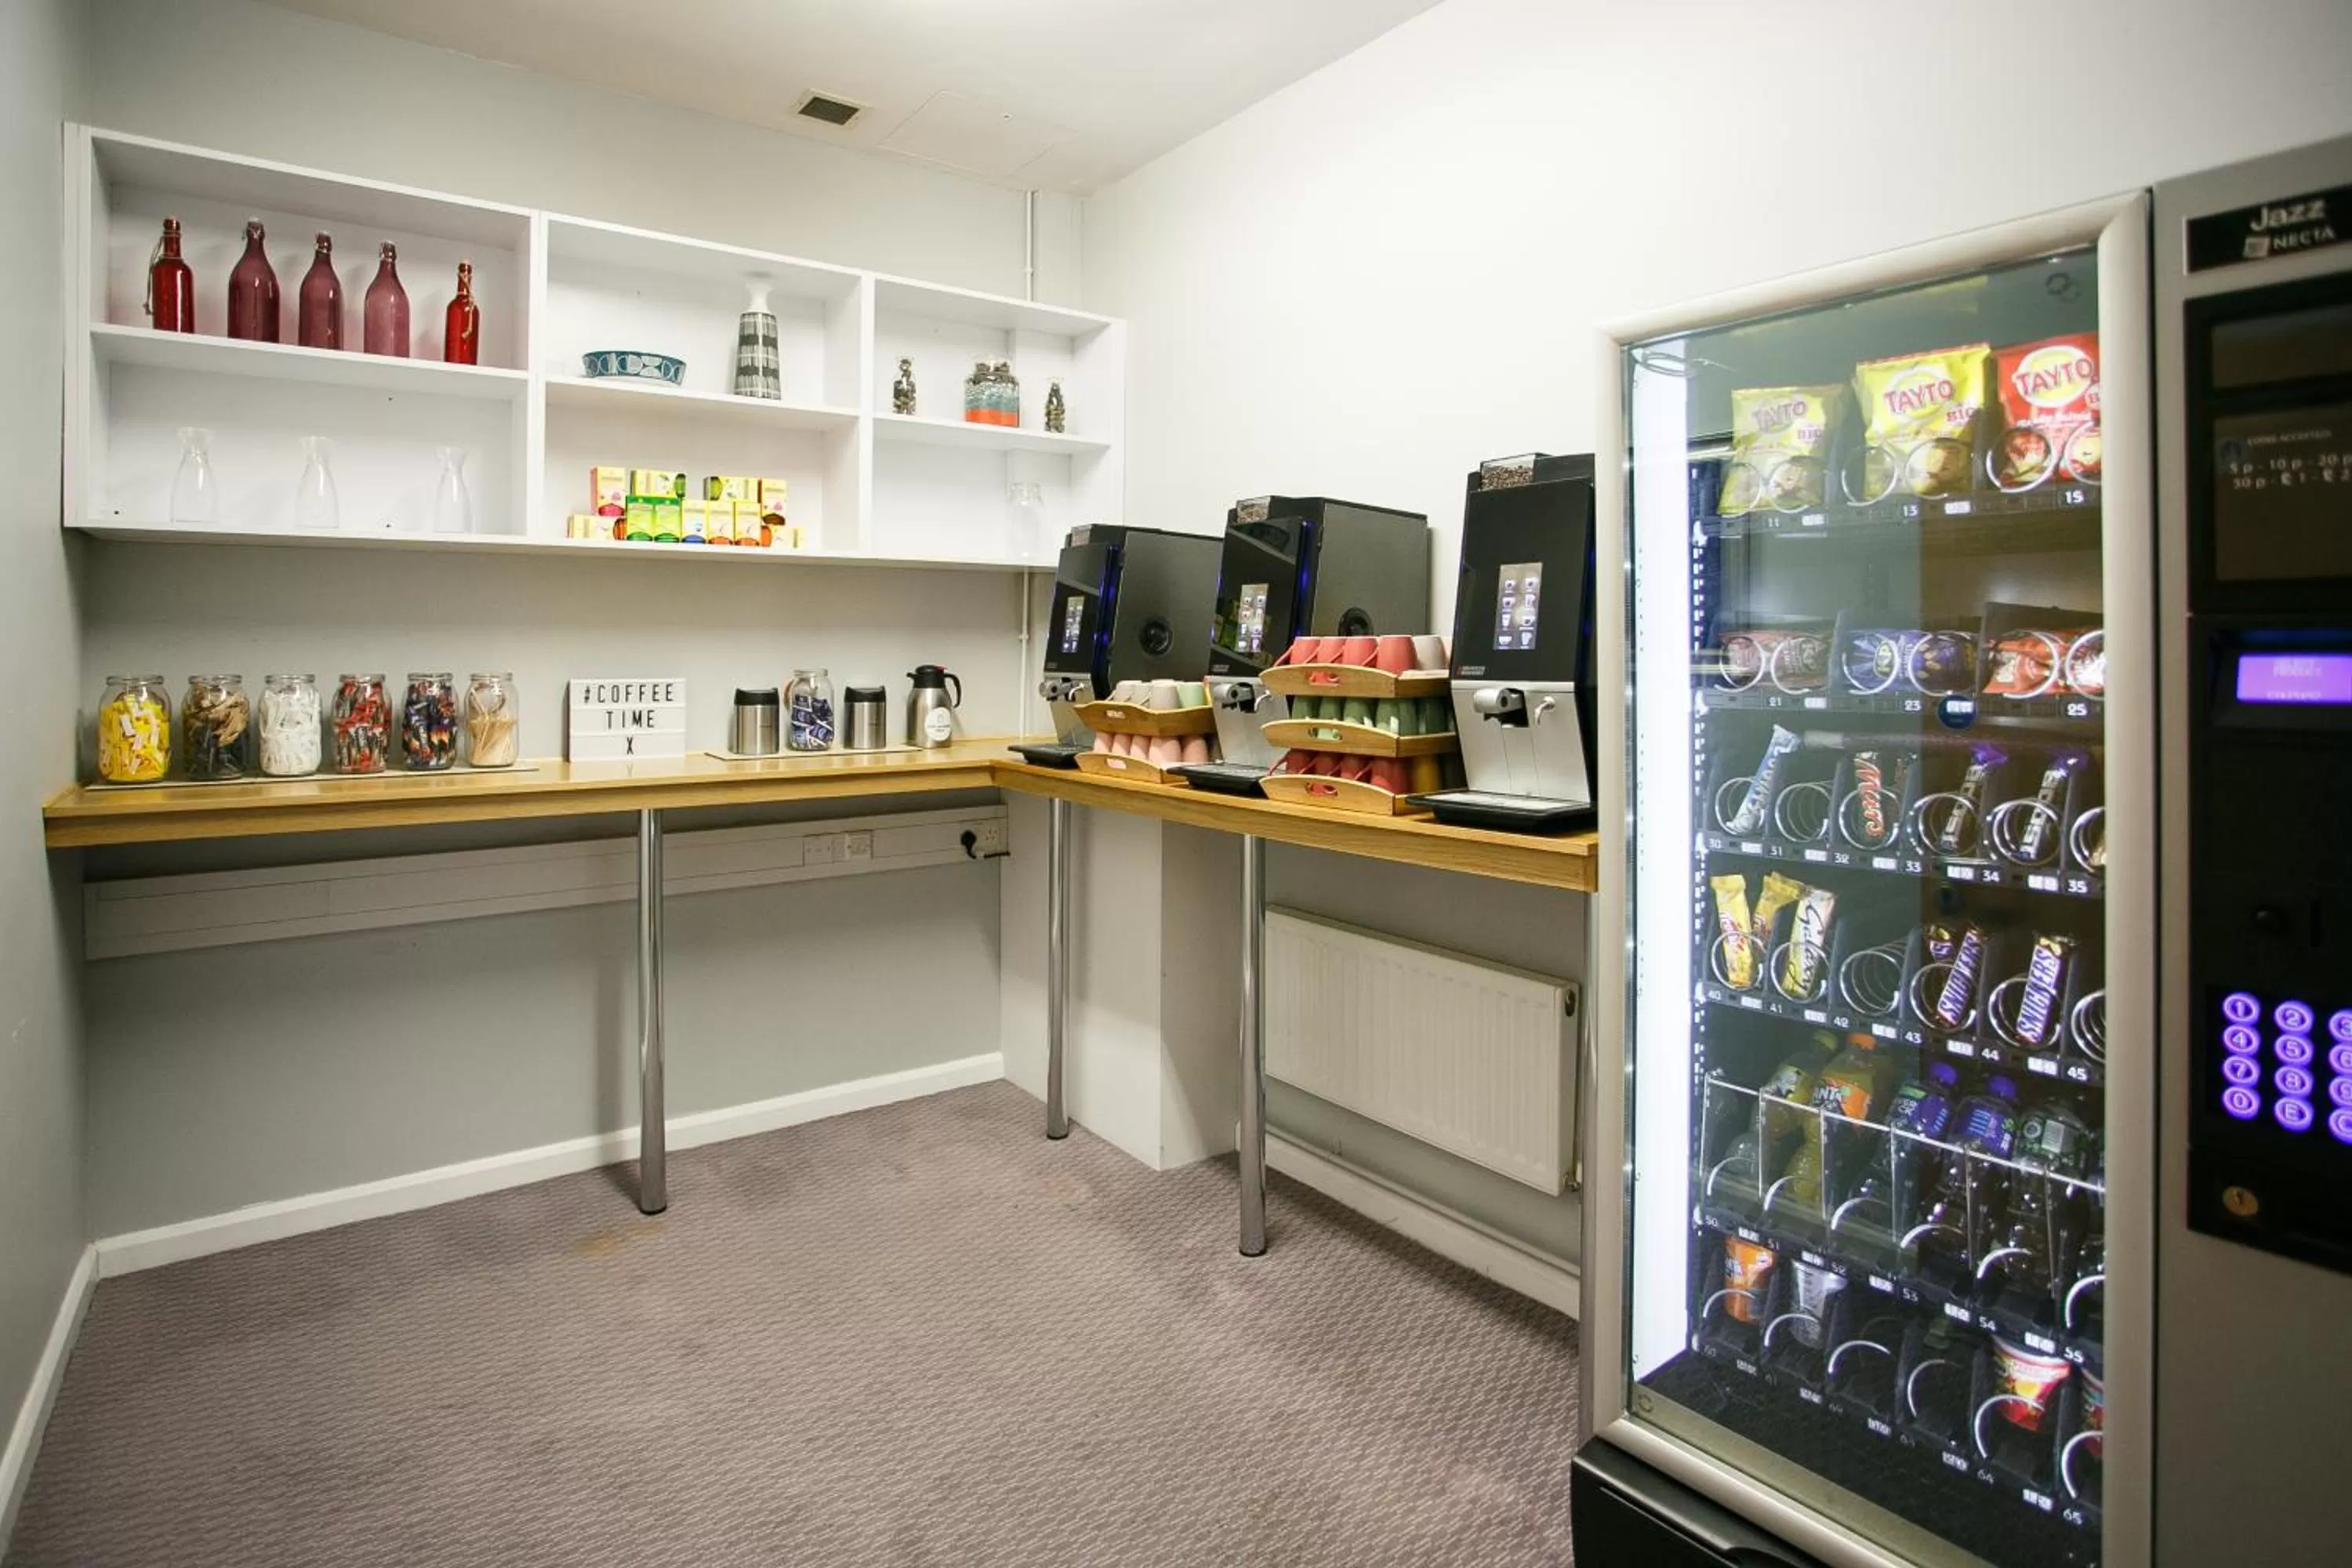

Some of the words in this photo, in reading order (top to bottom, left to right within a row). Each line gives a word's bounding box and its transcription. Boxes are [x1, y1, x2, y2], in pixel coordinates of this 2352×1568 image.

[2249, 199, 2326, 232] Jazz
[2274, 225, 2336, 249] NECTA
[2016, 358, 2094, 397] TAYTO
[1883, 379, 1955, 414] TAYTO
[1751, 400, 1808, 432] TAYTO
[2064, 490, 2085, 504] 15
[1768, 517, 1780, 528] 11
[583, 683, 674, 704] #COFFEE
[1769, 696, 1782, 707] 21
[2067, 702, 2088, 717] 25
[605, 710, 655, 730] TIME
[626, 736, 634, 755] X
[1906, 860, 1922, 873] 33
[1982, 869, 2001, 883] 34
[2067, 879, 2089, 894] 35
[1938, 936, 1983, 1022] SNICKERS
[2017, 946, 2055, 1043] SNICKERS
[1769, 1002, 1783, 1014] 41
[1833, 1015, 1849, 1028] 42
[2285, 1009, 2300, 1027] 2
[2340, 1018, 2352, 1037] 3
[1904, 1030, 1922, 1044] 43
[2232, 1030, 2246, 1047] 4
[1981, 1047, 2000, 1062] 44
[2285, 1040, 2299, 1058] 5
[2066, 1065, 2089, 1082] 45
[2232, 1062, 2245, 1080] 7
[2285, 1072, 2299, 1091] 8
[2232, 1092, 2247, 1109] 0
[2285, 1102, 2299, 1122] E
[1705, 1215, 1719, 1227] 50
[1902, 1287, 1919, 1303] 53
[1978, 1316, 1997, 1332] 54
[2063, 1345, 2084, 1363] 55
[2063, 1507, 2082, 1525] 65
